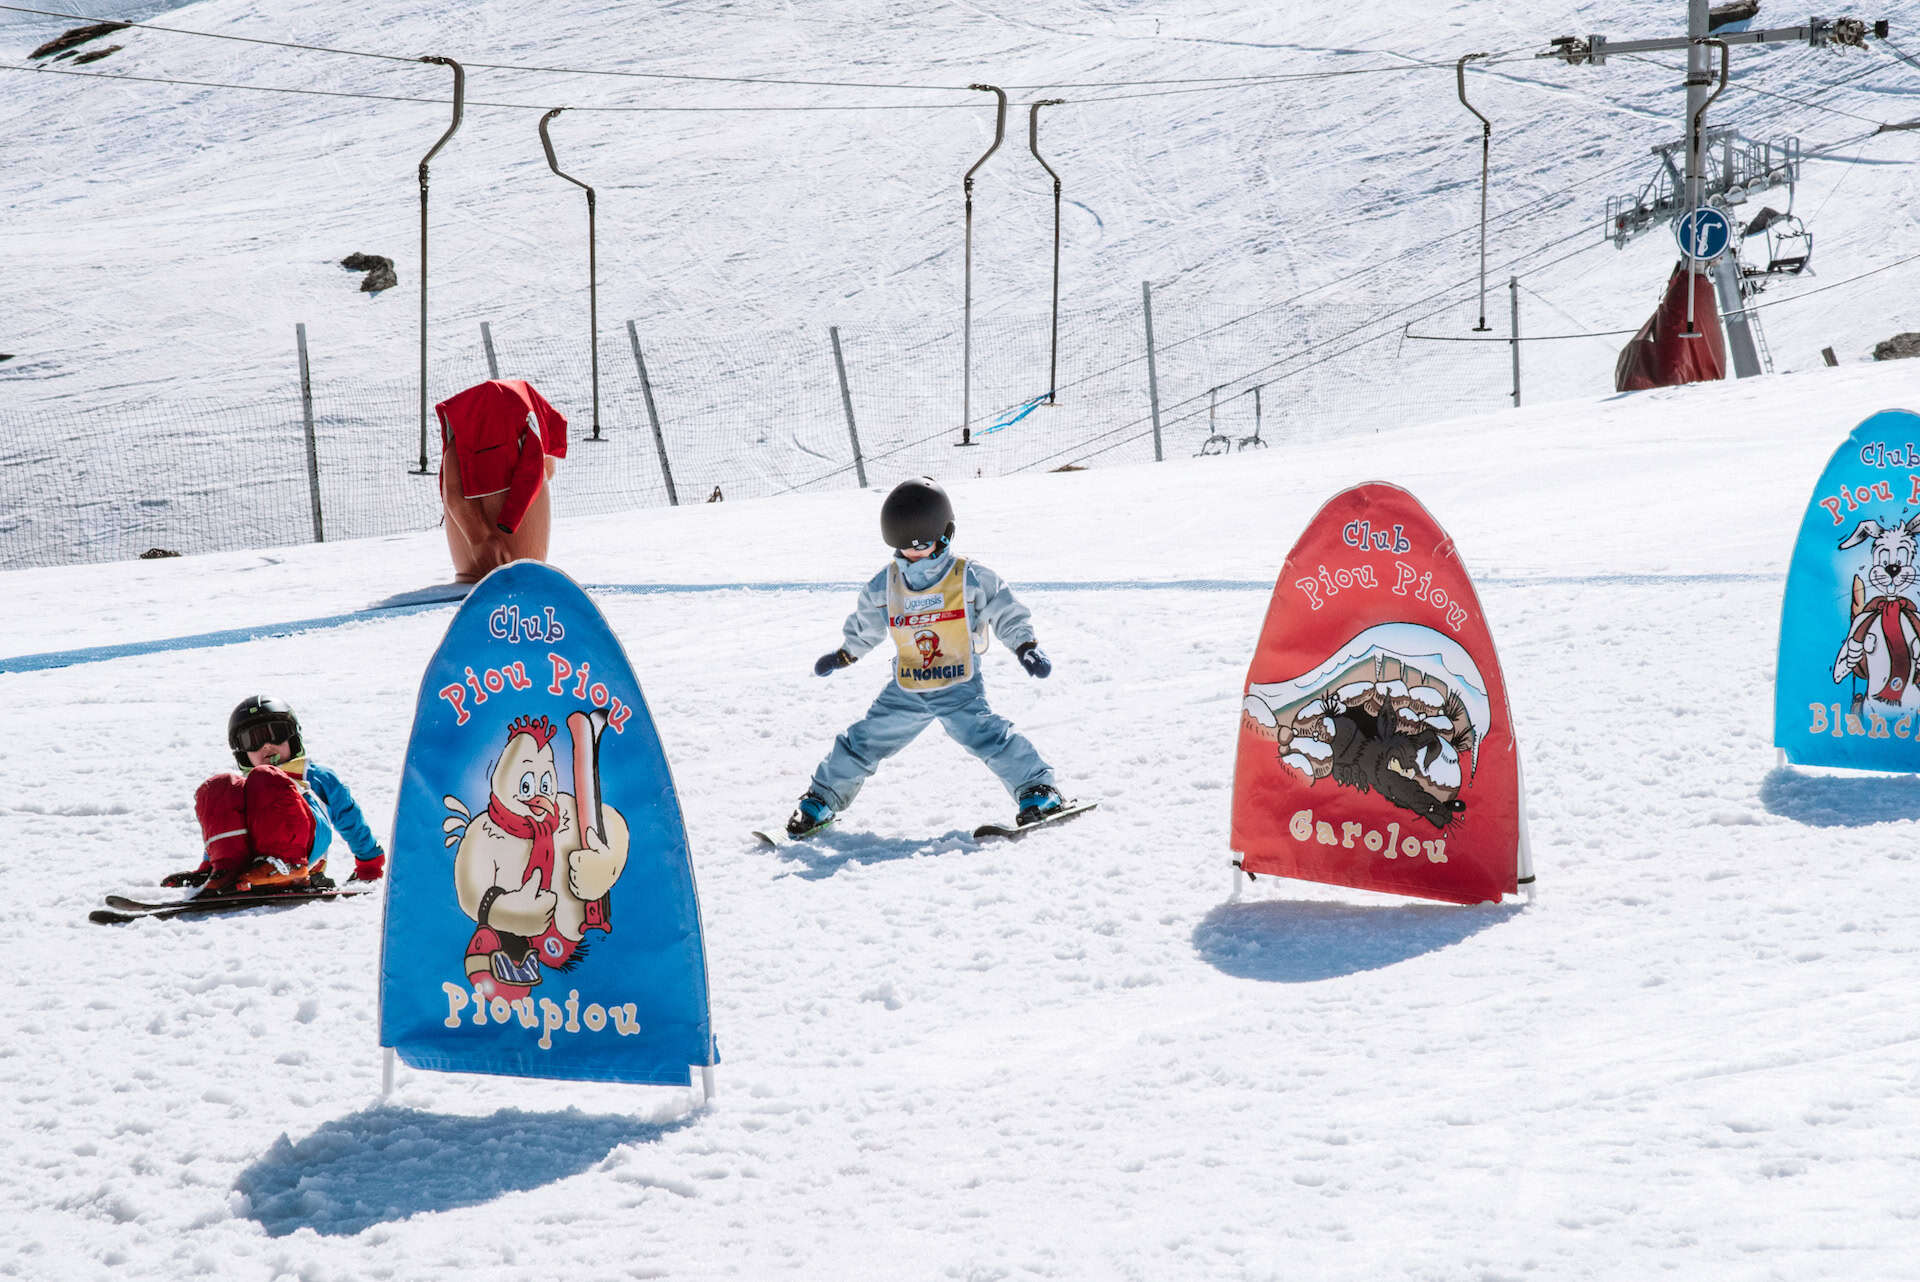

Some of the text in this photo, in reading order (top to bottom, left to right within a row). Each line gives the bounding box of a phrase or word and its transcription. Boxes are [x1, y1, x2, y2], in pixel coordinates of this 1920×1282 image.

[1860, 442, 1920, 468] Club
[1820, 481, 1893, 526] Piou
[1343, 520, 1411, 553] Club
[1296, 561, 1467, 632] Piou Piou
[489, 605, 565, 643] Club
[439, 653, 632, 734] Piou Piou
[901, 668, 911, 678] LA
[1809, 703, 1920, 742] Blanc
[1289, 809, 1448, 863] Garolou
[442, 982, 641, 1049] Pioupiou
